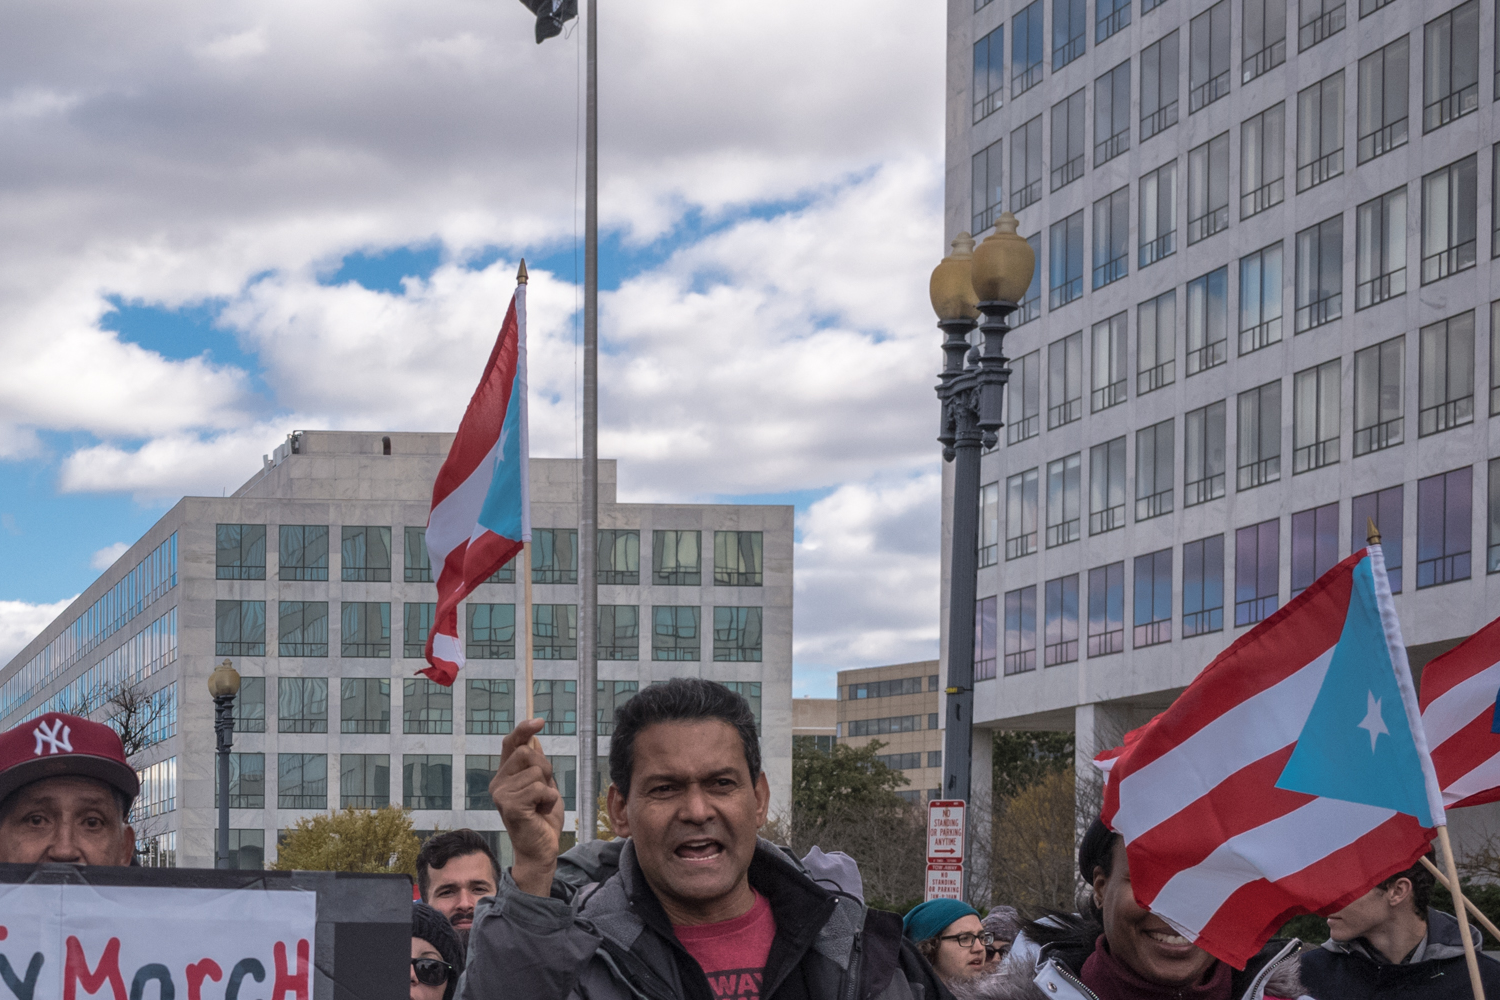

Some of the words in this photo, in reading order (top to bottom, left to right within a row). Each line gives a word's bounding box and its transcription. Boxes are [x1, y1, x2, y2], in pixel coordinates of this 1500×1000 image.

[942, 809, 951, 817] NO
[934, 819, 959, 827] STANDING
[930, 828, 937, 836] OR
[940, 828, 962, 837] PARKING
[934, 838, 956, 846] ANYTIME
